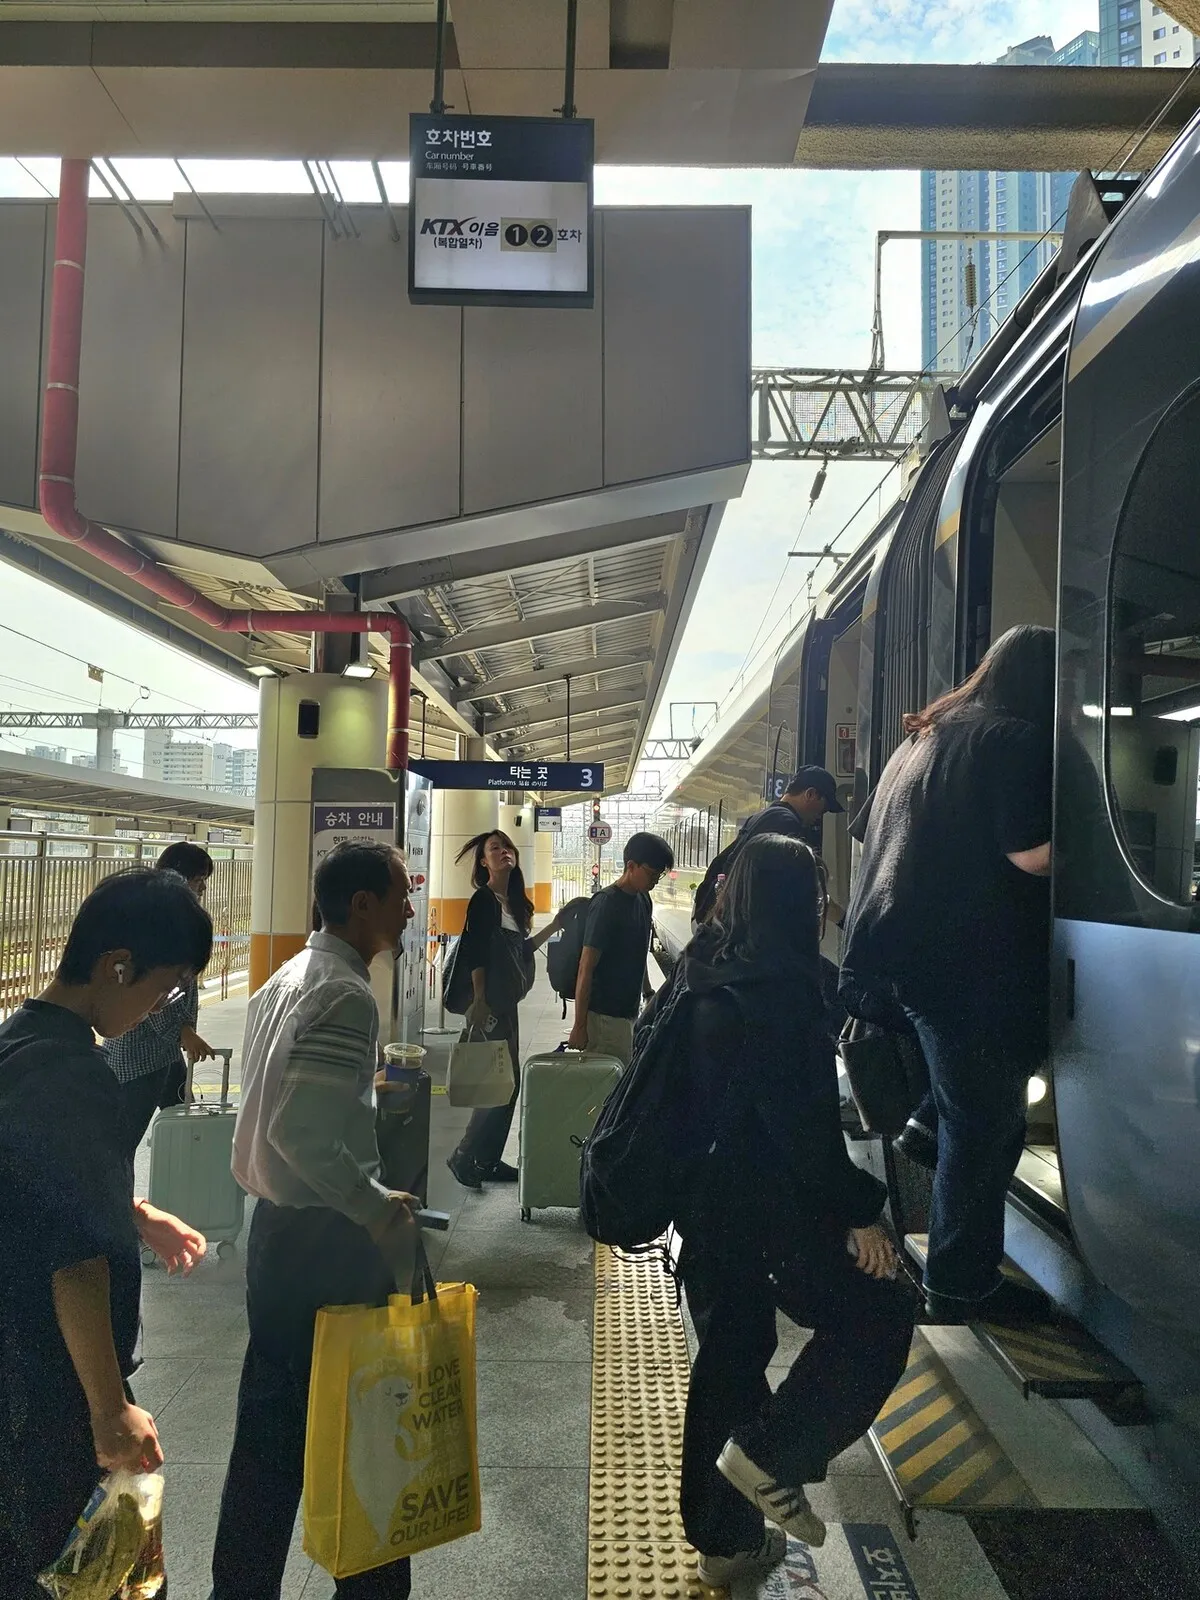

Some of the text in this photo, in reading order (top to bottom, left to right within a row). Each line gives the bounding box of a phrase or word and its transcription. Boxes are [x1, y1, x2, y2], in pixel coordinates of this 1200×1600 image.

[425, 128, 493, 149] 호차번호
[425, 151, 474, 161] Car number
[433, 237, 483, 249] (복합열차)
[556, 229, 583, 243] 호차
[488, 779, 517, 787] Platforms
[510, 766, 593, 787] 타는 곳 3
[325, 812, 384, 827] 승차 안내
[599, 829, 606, 837] A
[417, 1371, 422, 1389] I
[428, 1358, 460, 1387] LOVE
[418, 1379, 462, 1408] CLEAN
[412, 1399, 464, 1431] WATER
[400, 1472, 470, 1523] SAVE
[390, 1502, 470, 1546] OUR LIFE!
